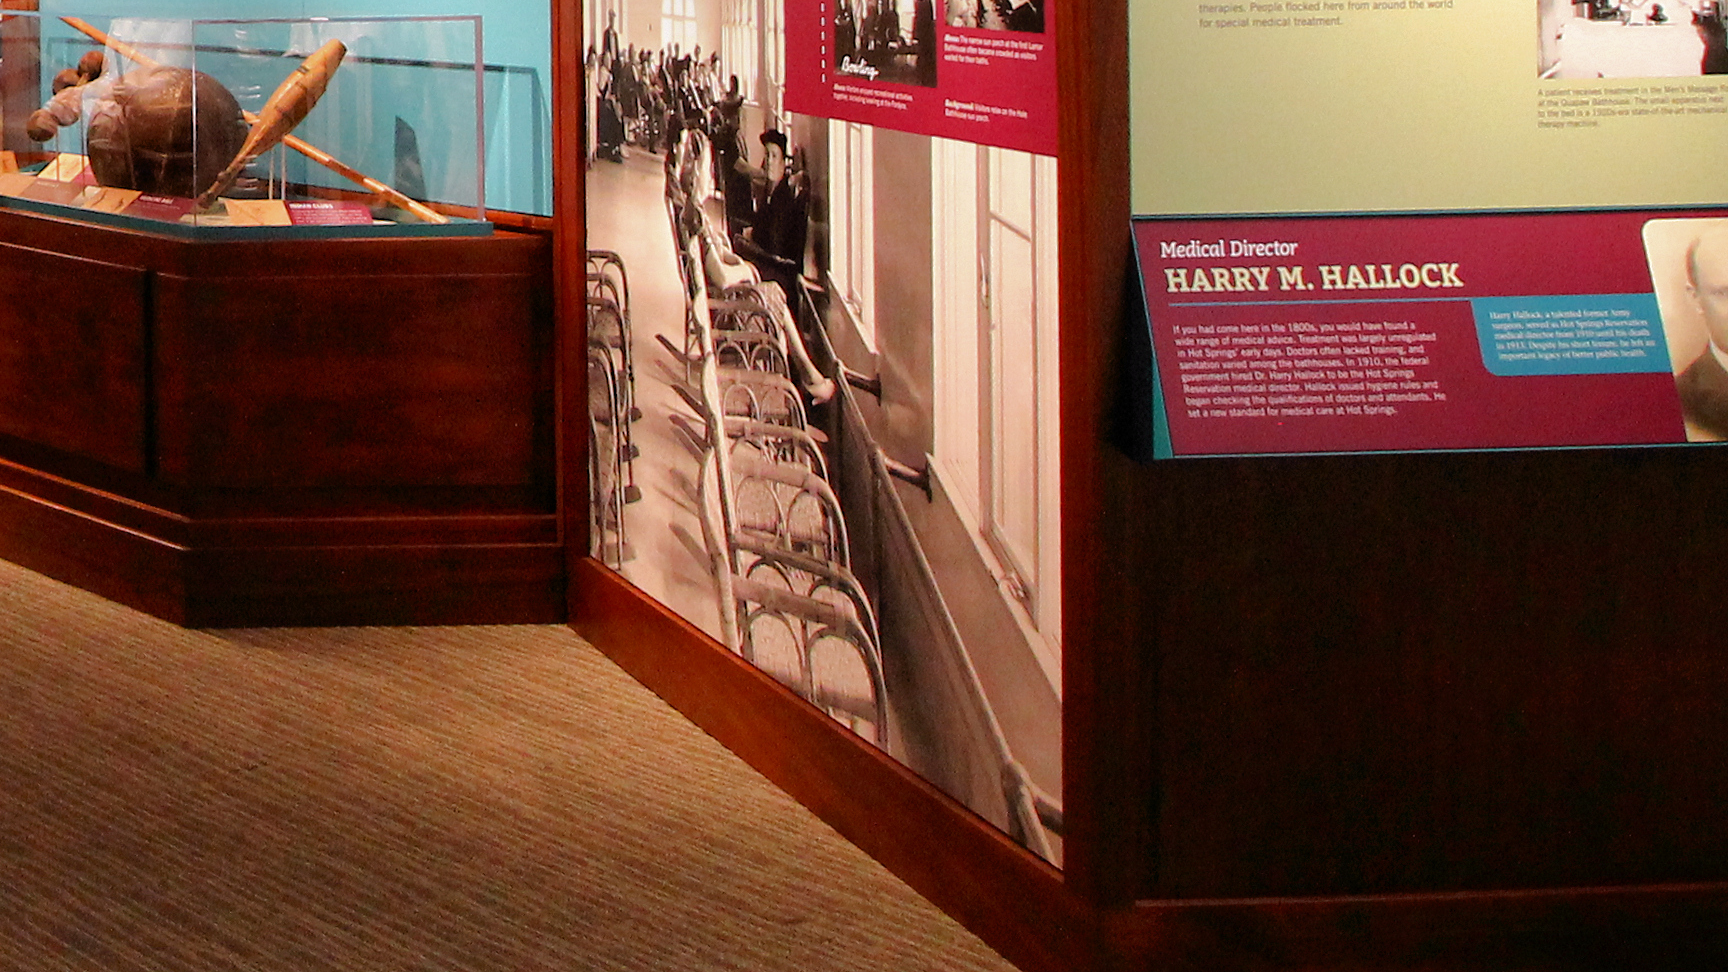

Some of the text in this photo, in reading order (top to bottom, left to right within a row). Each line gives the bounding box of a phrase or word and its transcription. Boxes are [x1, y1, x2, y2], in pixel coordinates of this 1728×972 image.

[1160, 239, 1298, 258] Medical Director
[1164, 262, 1464, 293] HARRY M. HALLOCK
